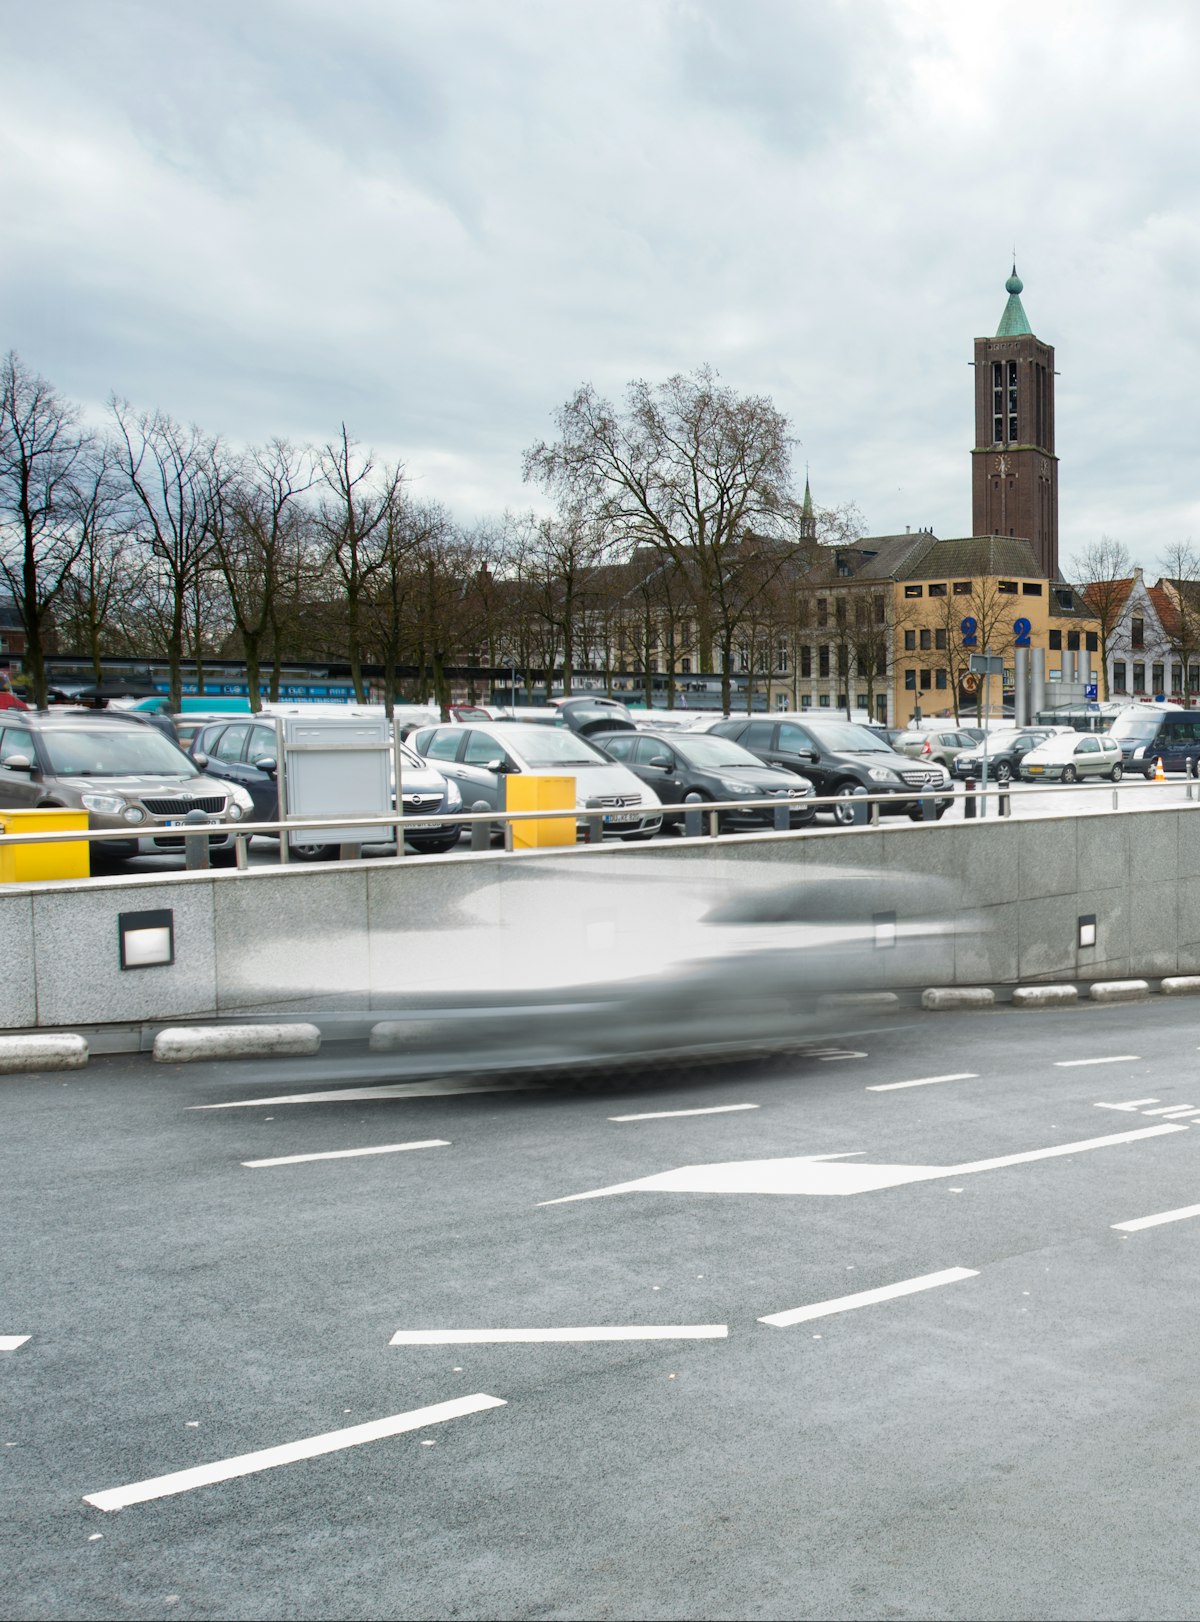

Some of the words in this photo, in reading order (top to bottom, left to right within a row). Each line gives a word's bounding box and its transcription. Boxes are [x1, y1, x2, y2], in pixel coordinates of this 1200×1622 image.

[961, 616, 977, 646] 2
[1013, 617, 1031, 647] 2
[1086, 685, 1091, 694] P
